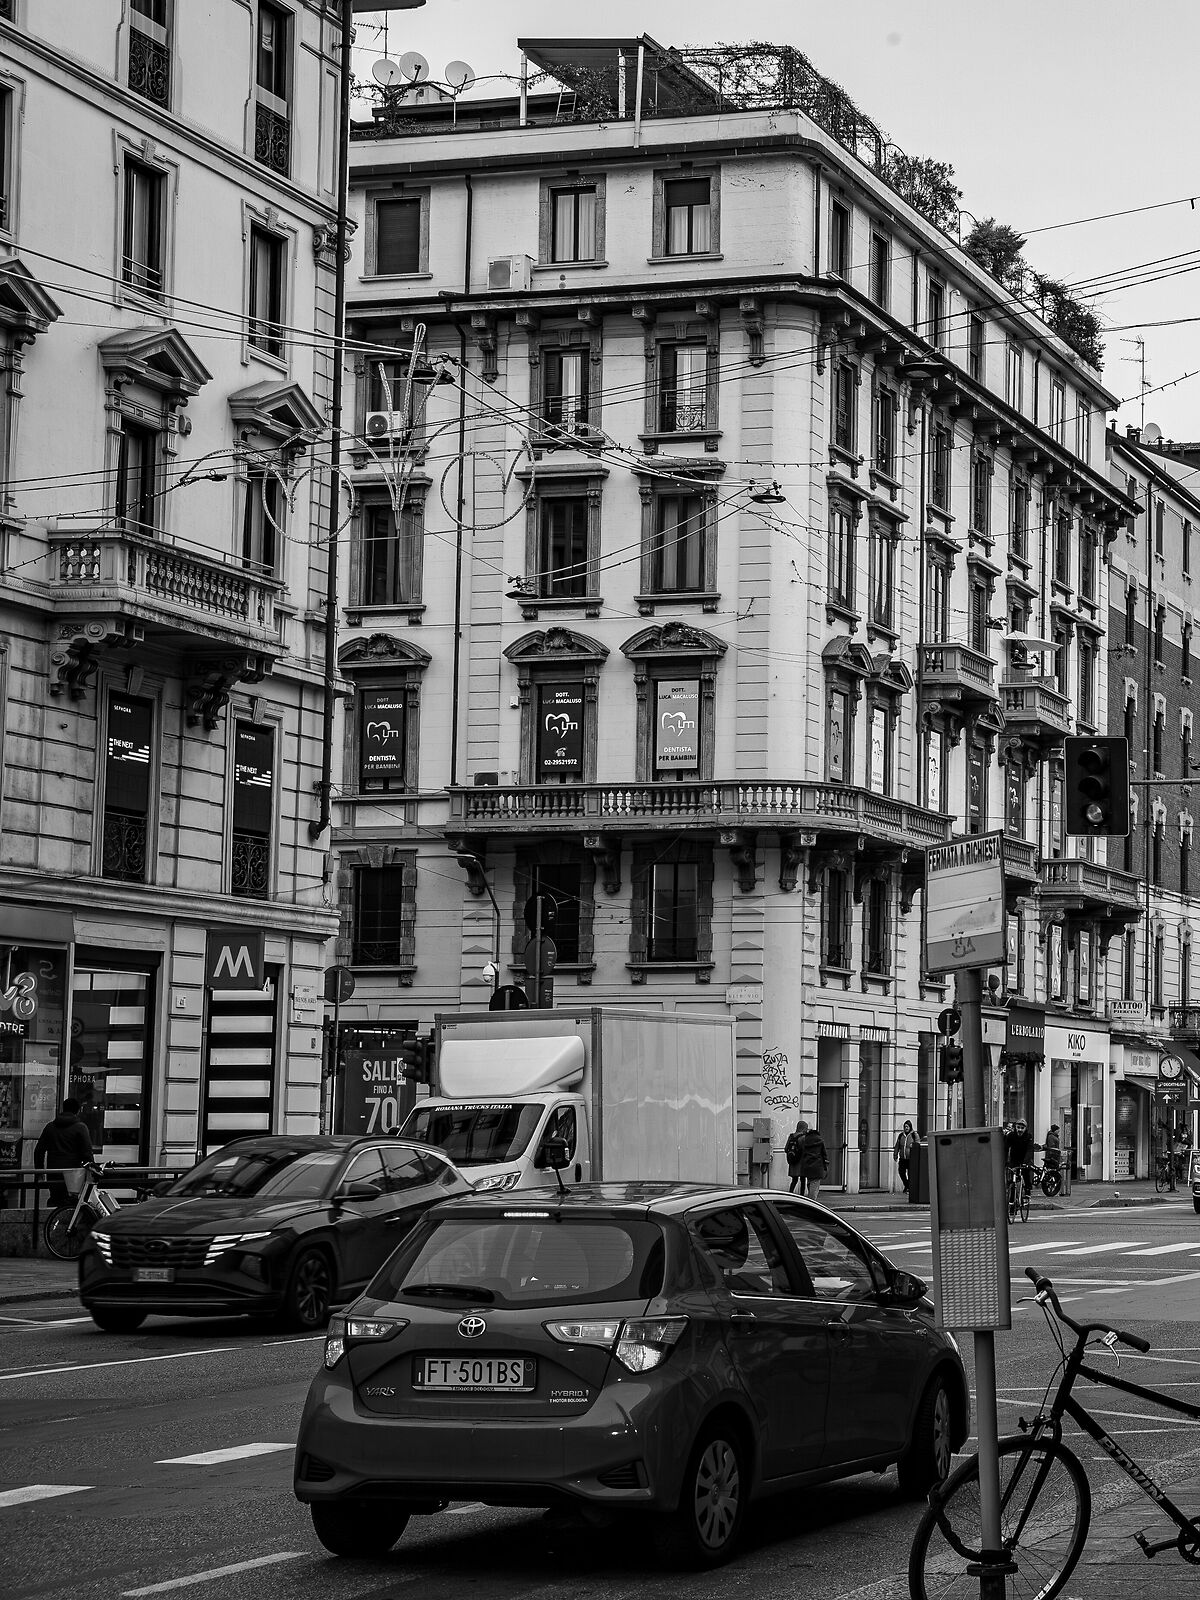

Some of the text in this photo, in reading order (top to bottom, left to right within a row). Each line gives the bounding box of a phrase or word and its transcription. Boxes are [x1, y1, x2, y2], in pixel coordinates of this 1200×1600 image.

[113, 738, 133, 749] THE NEXT
[368, 754, 396, 762] DENTISTA
[928, 836, 1000, 872] FERMATA A RICHIESTA
[1112, 1002, 1143, 1010] TATTOO
[1011, 1024, 1045, 1039] L'ERBOLARIO
[1067, 1033, 1086, 1051] KIKO
[69, 1074, 96, 1083] EPHORA
[373, 1085, 393, 1094] FINO A
[427, 1360, 521, 1384] FT 501BS
[366, 1386, 396, 1397] YARIS
